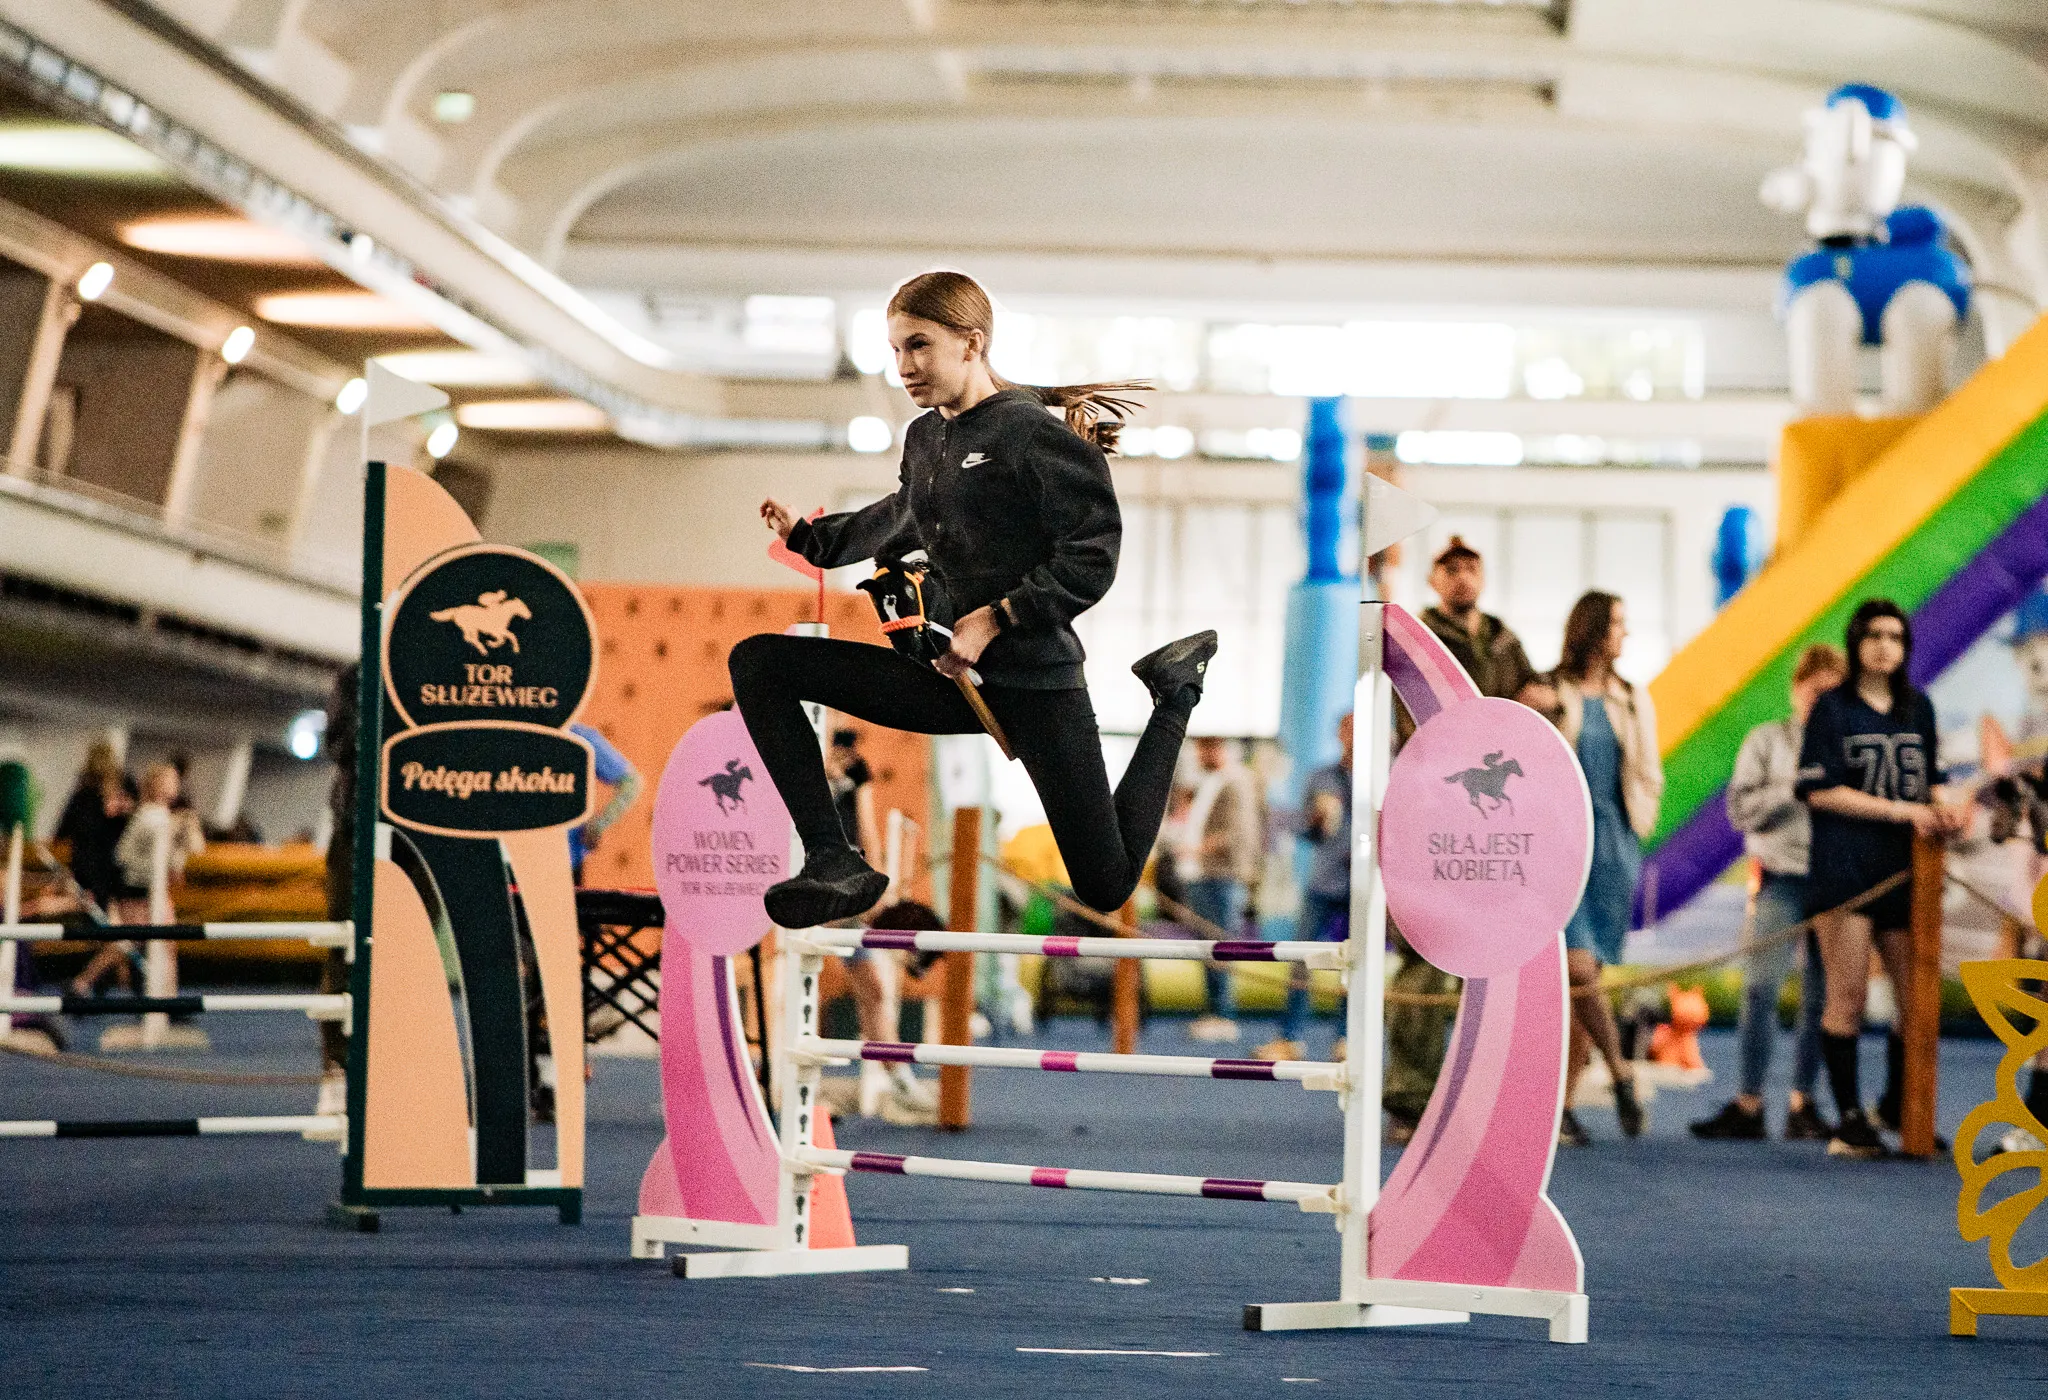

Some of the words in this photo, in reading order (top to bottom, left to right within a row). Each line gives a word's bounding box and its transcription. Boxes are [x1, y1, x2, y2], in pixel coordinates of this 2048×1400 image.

[463, 663, 513, 686] TOR
[400, 761, 493, 800] Potęga
[495, 765, 576, 794] skoku
[692, 830, 755, 851] WOMEN
[1427, 832, 1477, 855] SIŁA
[1479, 832, 1534, 855] JEST
[665, 852, 723, 874] POWER
[725, 853, 781, 875] SERIES
[1433, 858, 1527, 887] KOBIETĄ
